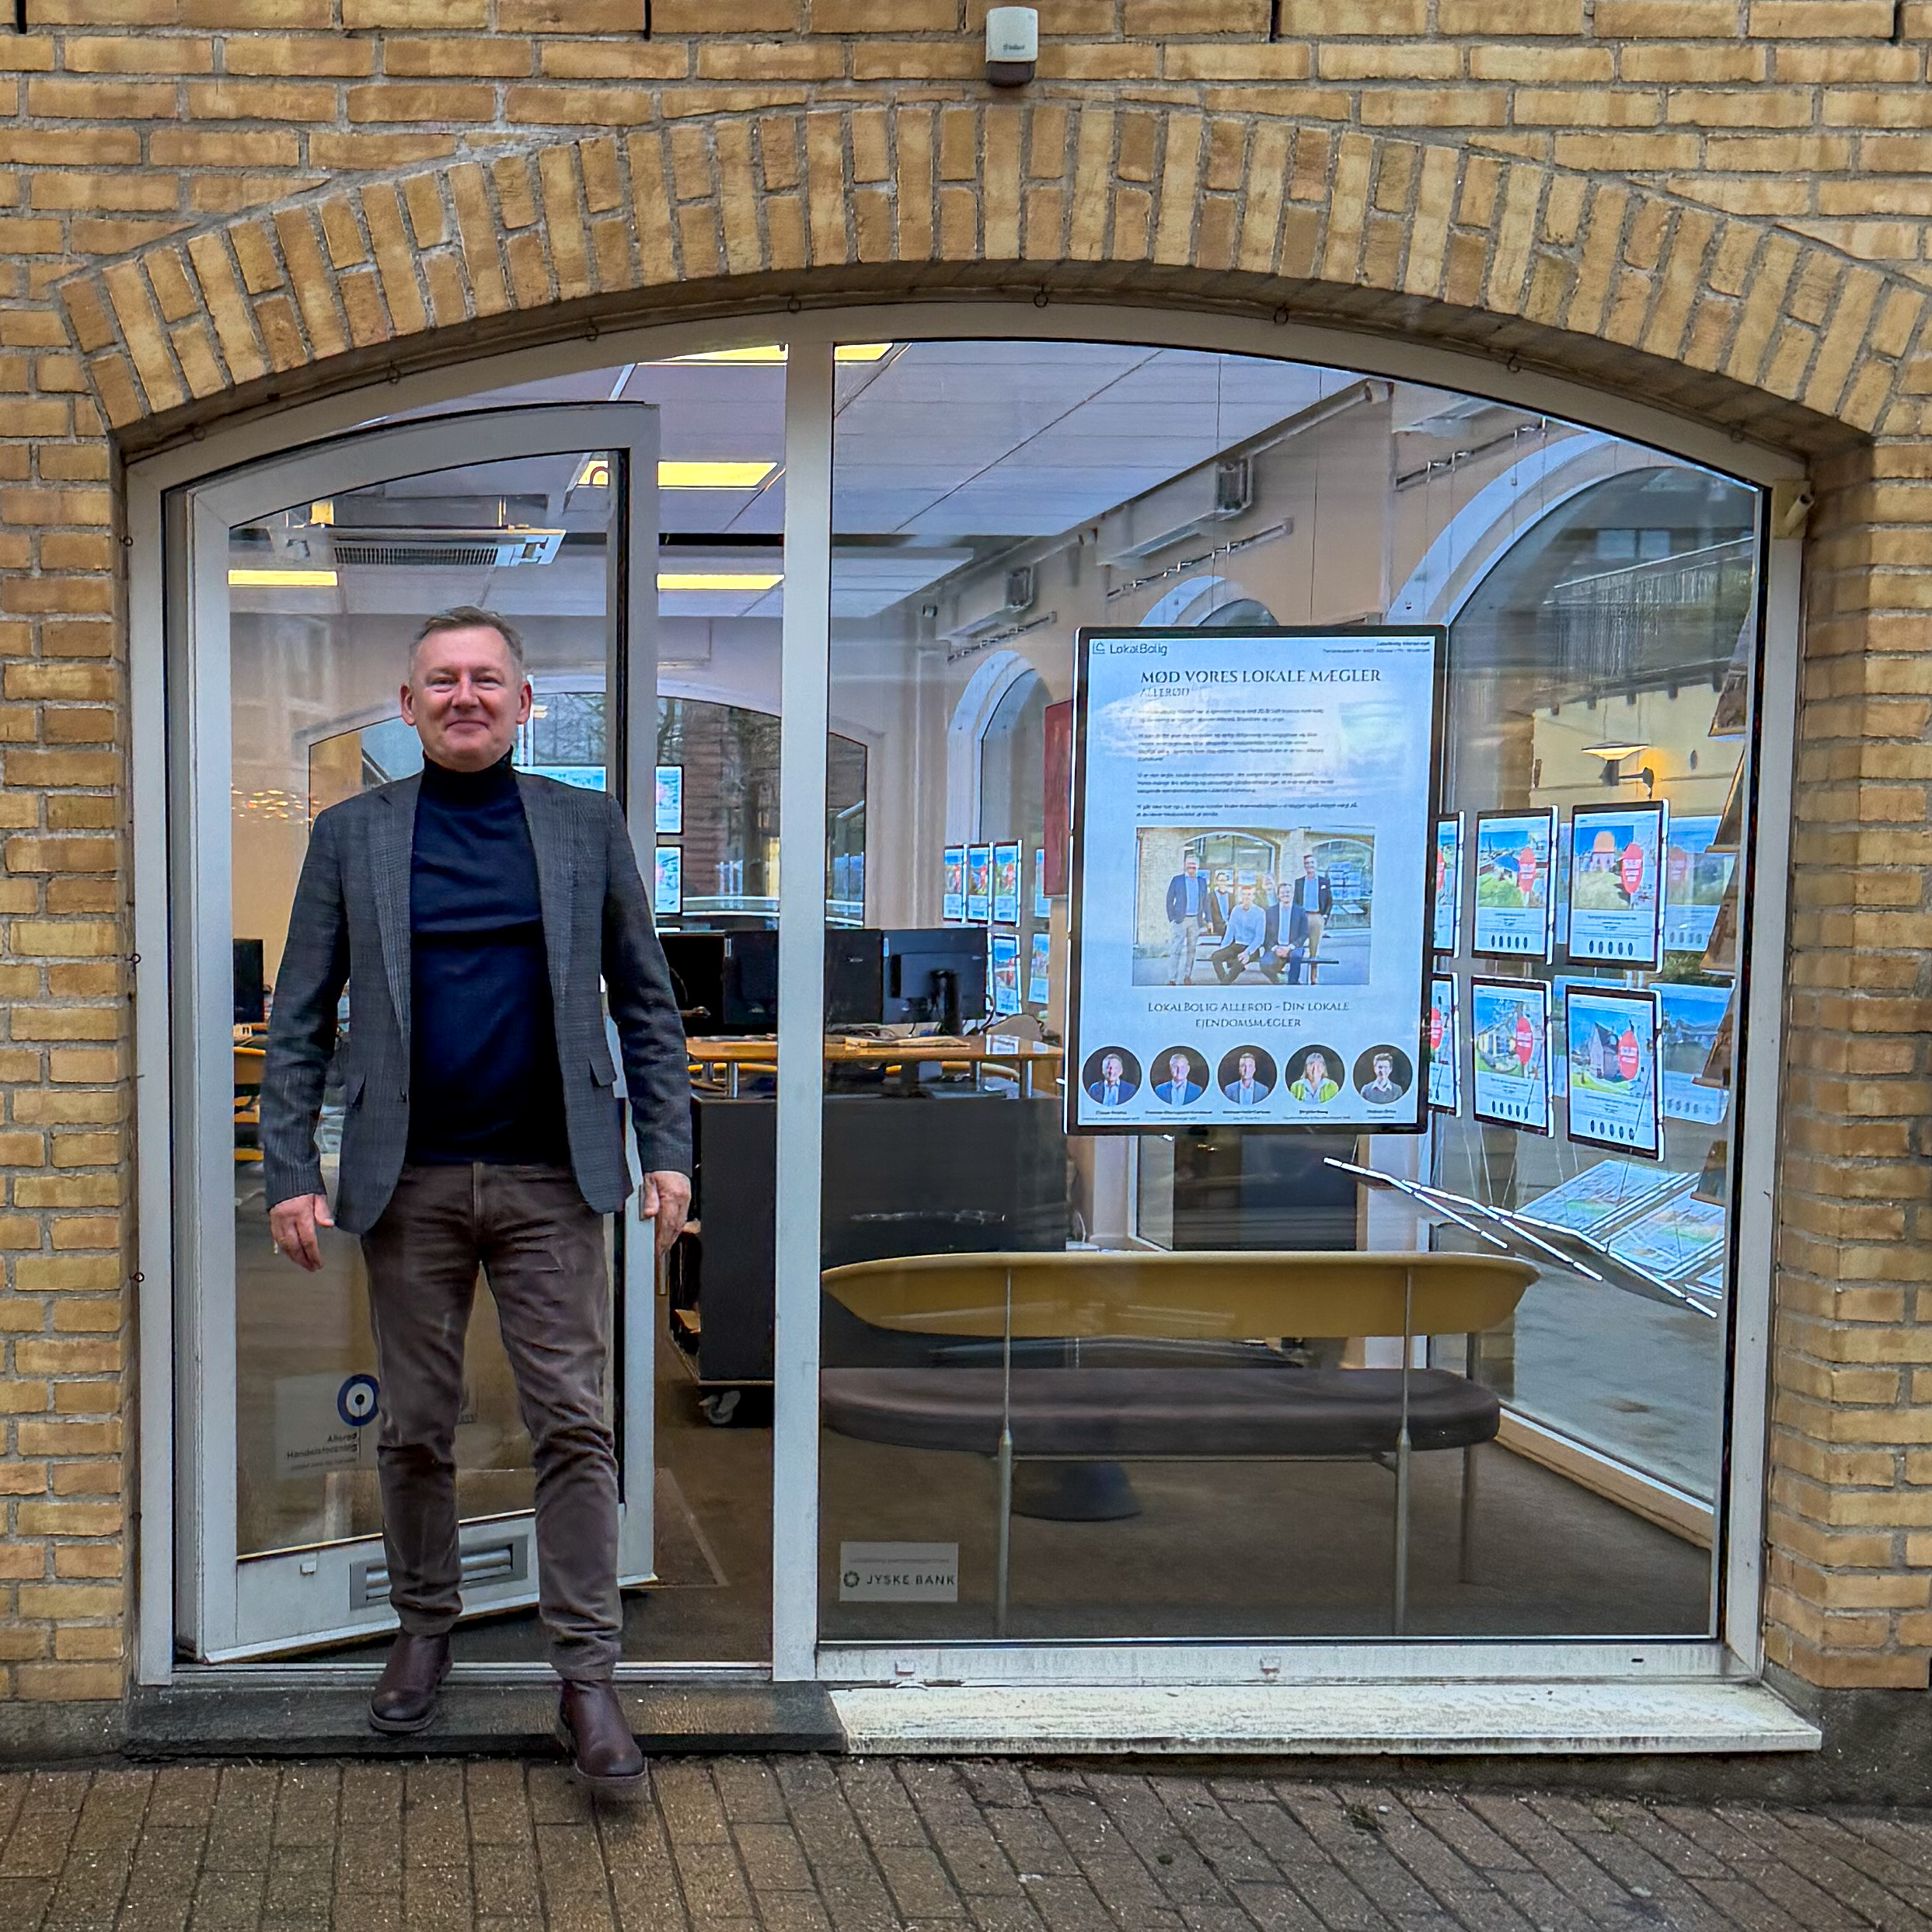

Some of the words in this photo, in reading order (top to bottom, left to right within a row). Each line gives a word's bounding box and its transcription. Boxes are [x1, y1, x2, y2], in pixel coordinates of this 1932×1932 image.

[1110, 643, 1168, 656] LokalBolig
[1140, 670, 1180, 683] MØD
[1184, 670, 1238, 683] VORES
[1243, 669, 1306, 682] LOKALE
[1309, 668, 1381, 682] MÆGLER
[1139, 687, 1190, 698] ALLERØD
[867, 1575, 910, 1585] JYSKE
[915, 1575, 955, 1585] BANK
